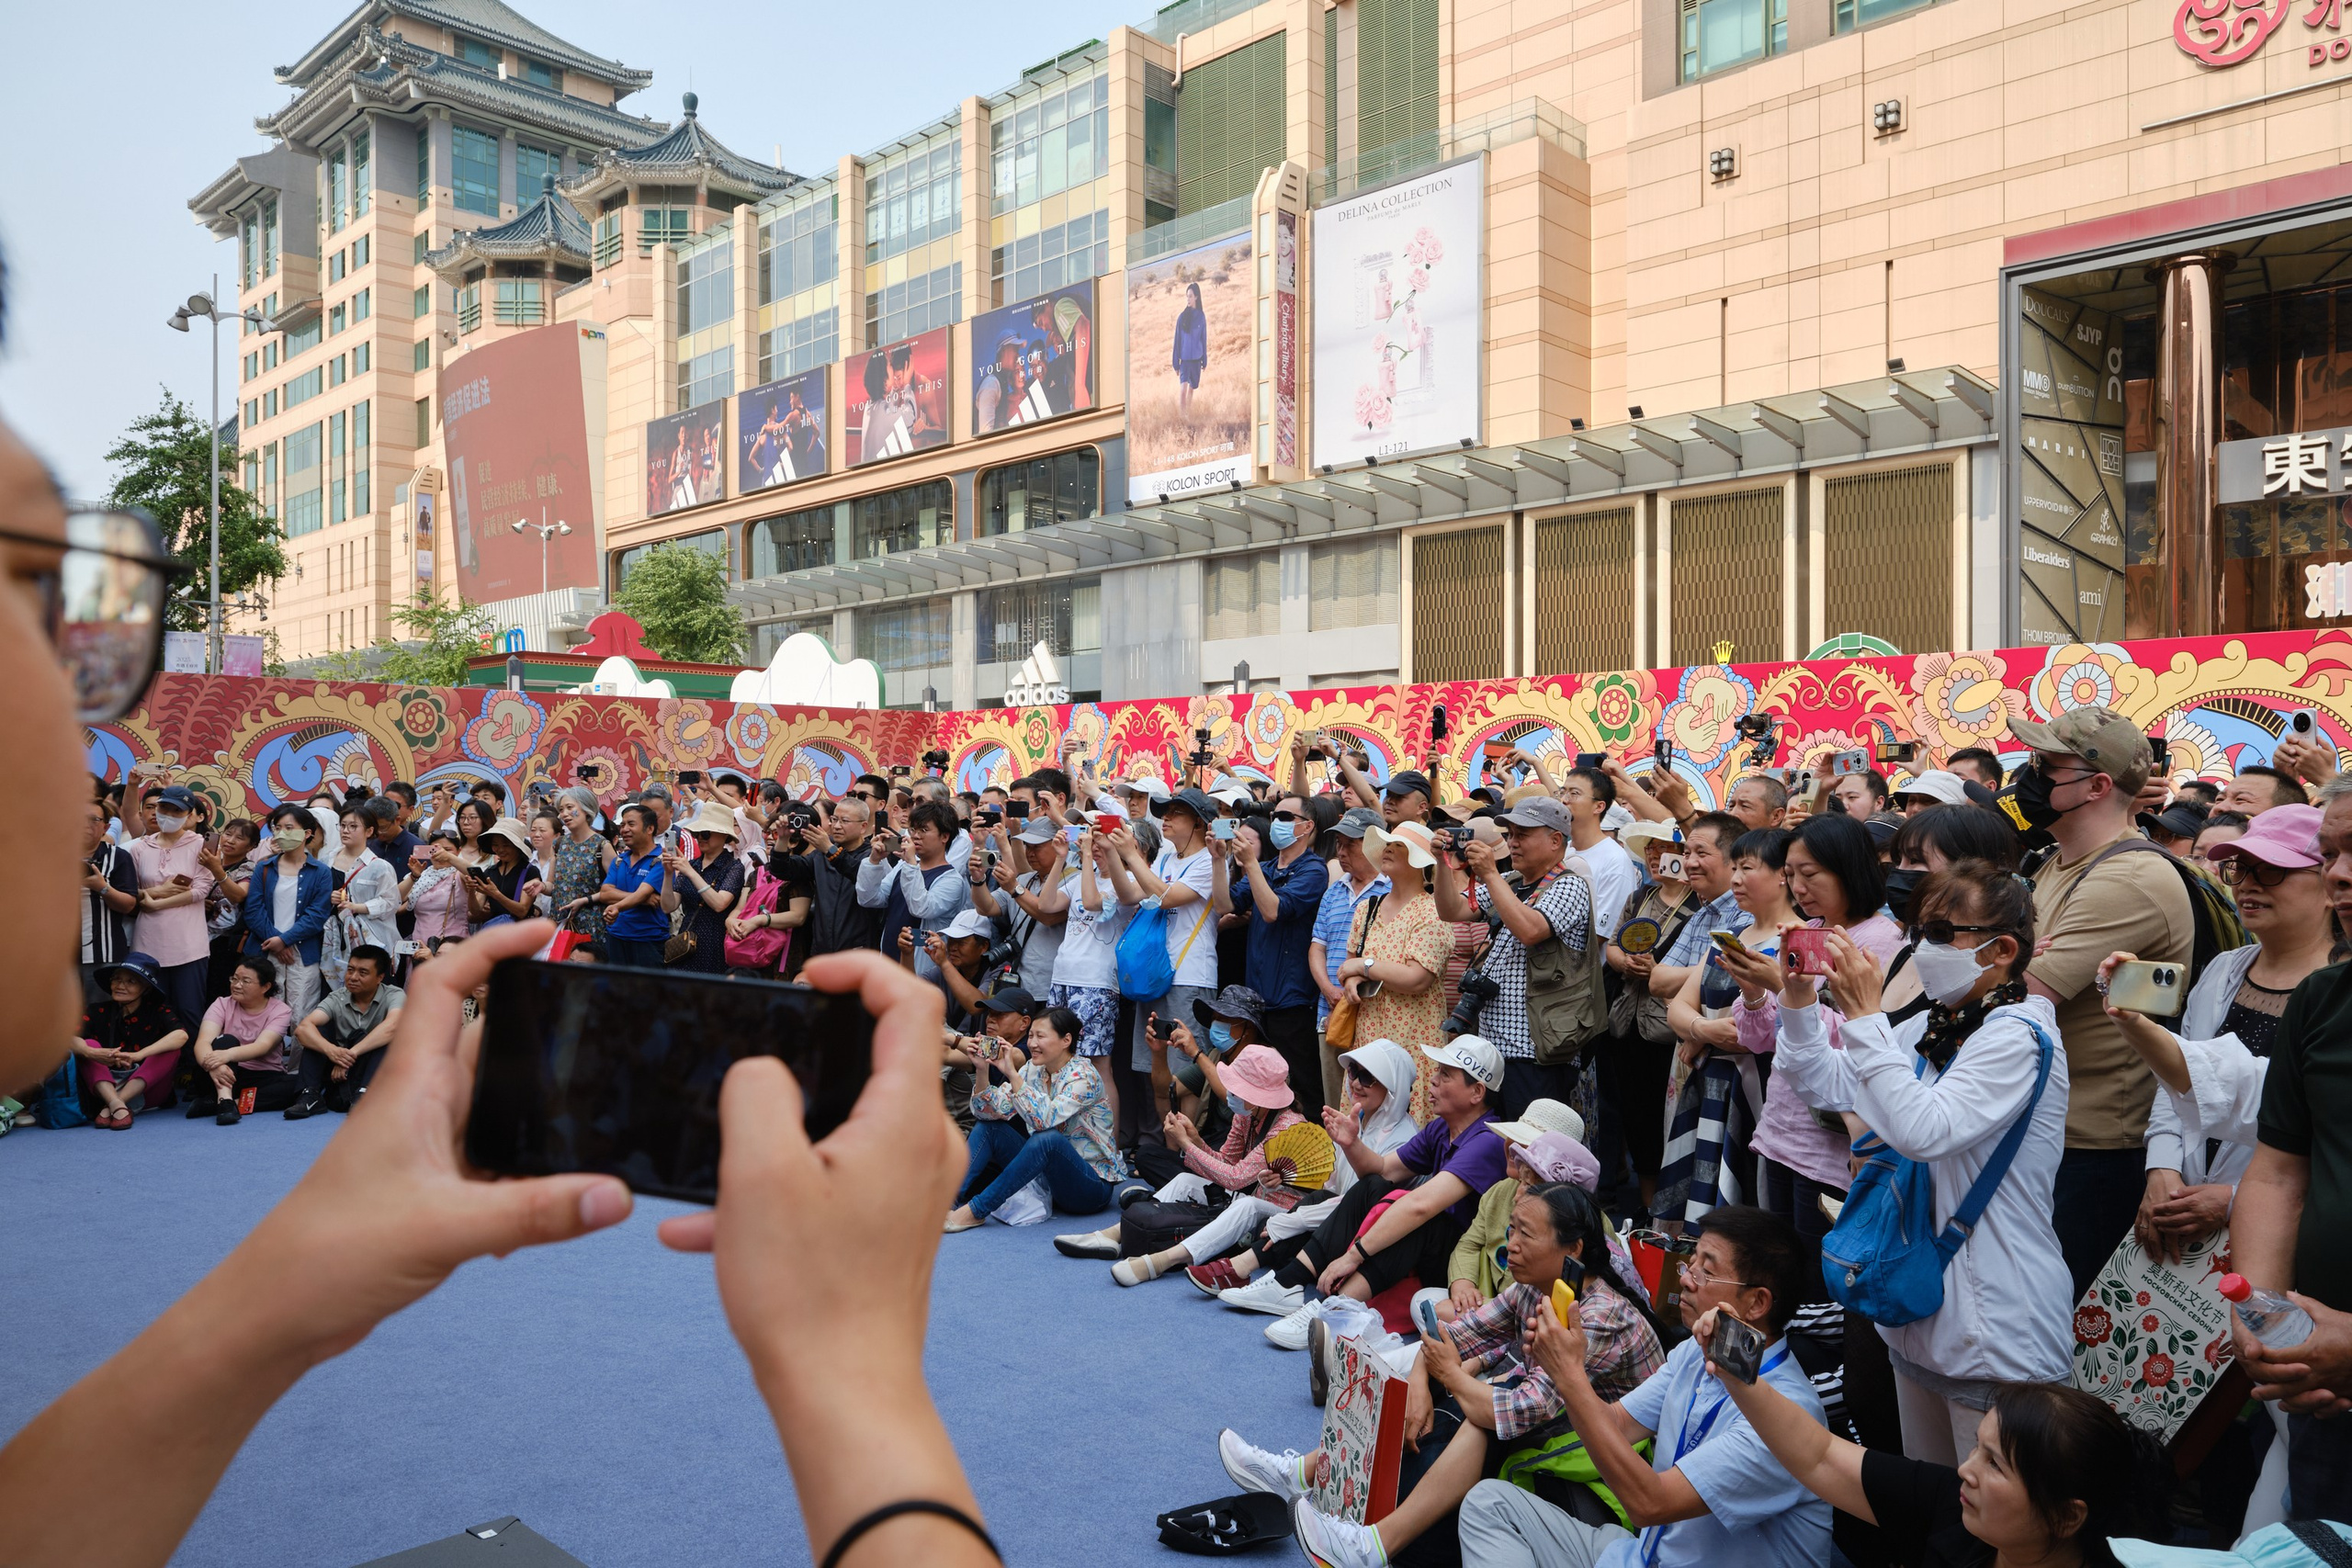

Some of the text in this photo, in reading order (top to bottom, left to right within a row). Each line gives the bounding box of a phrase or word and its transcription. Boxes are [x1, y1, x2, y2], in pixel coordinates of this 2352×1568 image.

[1338, 177, 1453, 221] DELINA COLLECTION
[1367, 209, 1393, 220] PARFUMS
[1402, 200, 1421, 211] MARLY
[2025, 295, 2070, 324] DOUCAL'S
[581, 328, 605, 340] apm
[2077, 323, 2102, 345] SJYP
[978, 337, 1087, 377] YOU GOT THIS
[852, 378, 943, 413] YOU GOT THIS
[773, 423, 790, 436] GOT
[800, 413, 821, 428] THIS
[1177, 450, 1199, 461] KOLON
[1200, 445, 1219, 457] SPORT
[1220, 441, 1235, 453] 可隆
[1379, 441, 1408, 456] L1-121
[2028, 436, 2086, 459] MARNI
[651, 458, 667, 470] YOU
[1166, 468, 1236, 493] KOLON SPORT
[2023, 546, 2070, 570] Liberaiders
[2079, 588, 2102, 606] ami
[2023, 628, 2073, 646] THOM BROWNE
[1004, 682, 1070, 708] adidas
[1525, 807, 1540, 817] Jeep
[1456, 1050, 1494, 1083] LOVED
[2146, 1260, 2226, 1325] 莫斯科文化节
[2141, 1274, 2215, 1335] МОСКОВСКИЕ СЕЗОНЫ
